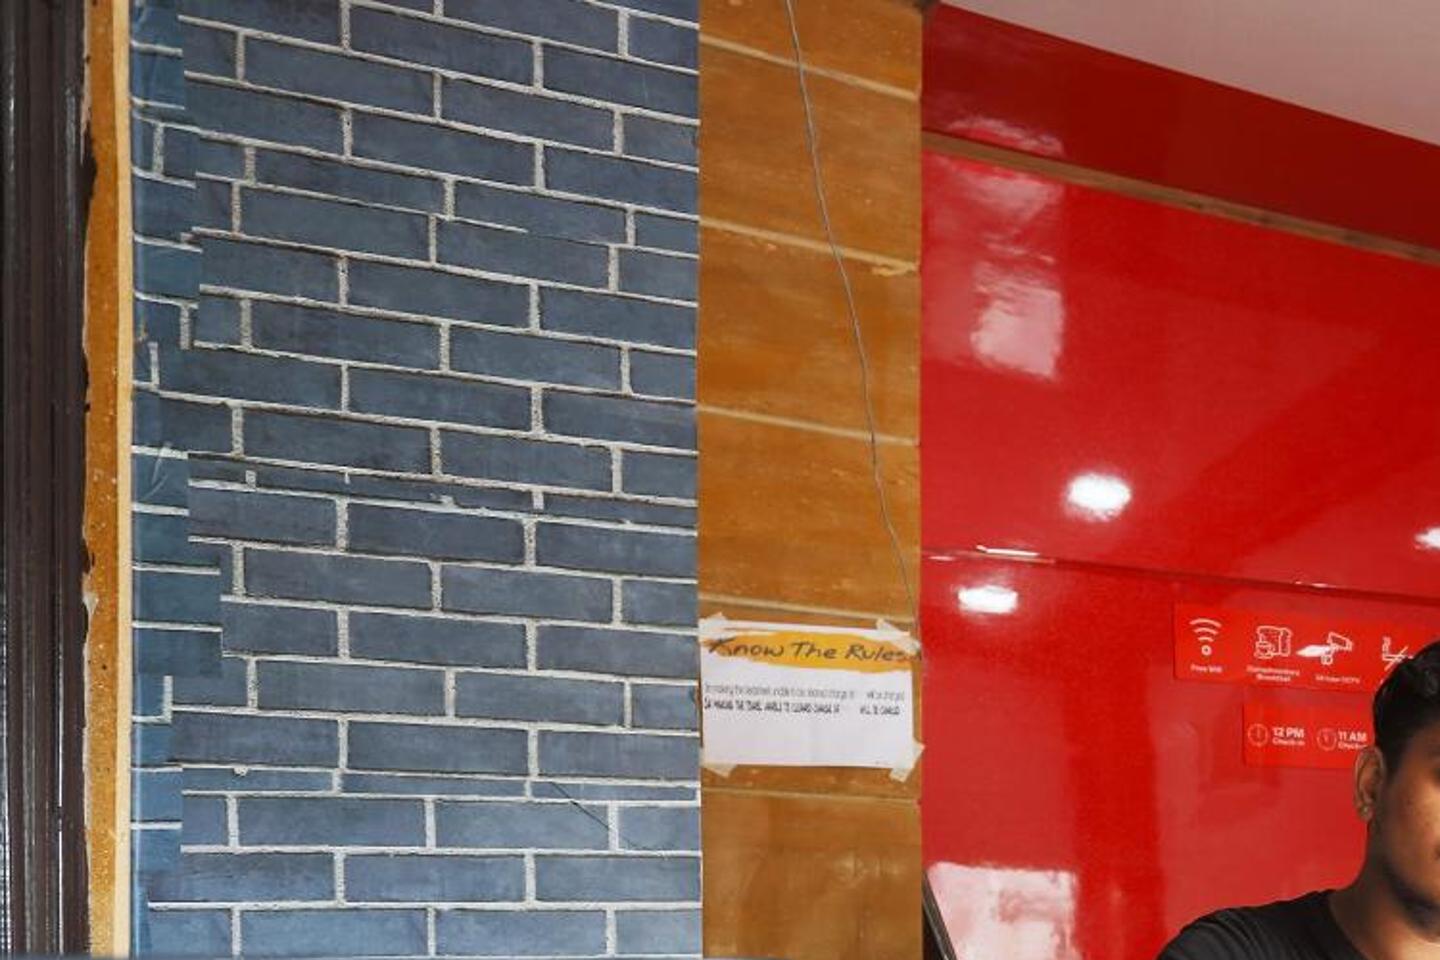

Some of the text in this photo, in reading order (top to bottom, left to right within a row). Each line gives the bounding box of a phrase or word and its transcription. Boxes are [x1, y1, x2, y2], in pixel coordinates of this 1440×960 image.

[708, 635, 784, 657] Know
[791, 641, 836, 659] The
[1272, 727, 1305, 738] 12 PM
[1338, 730, 1367, 742] 11 AM
